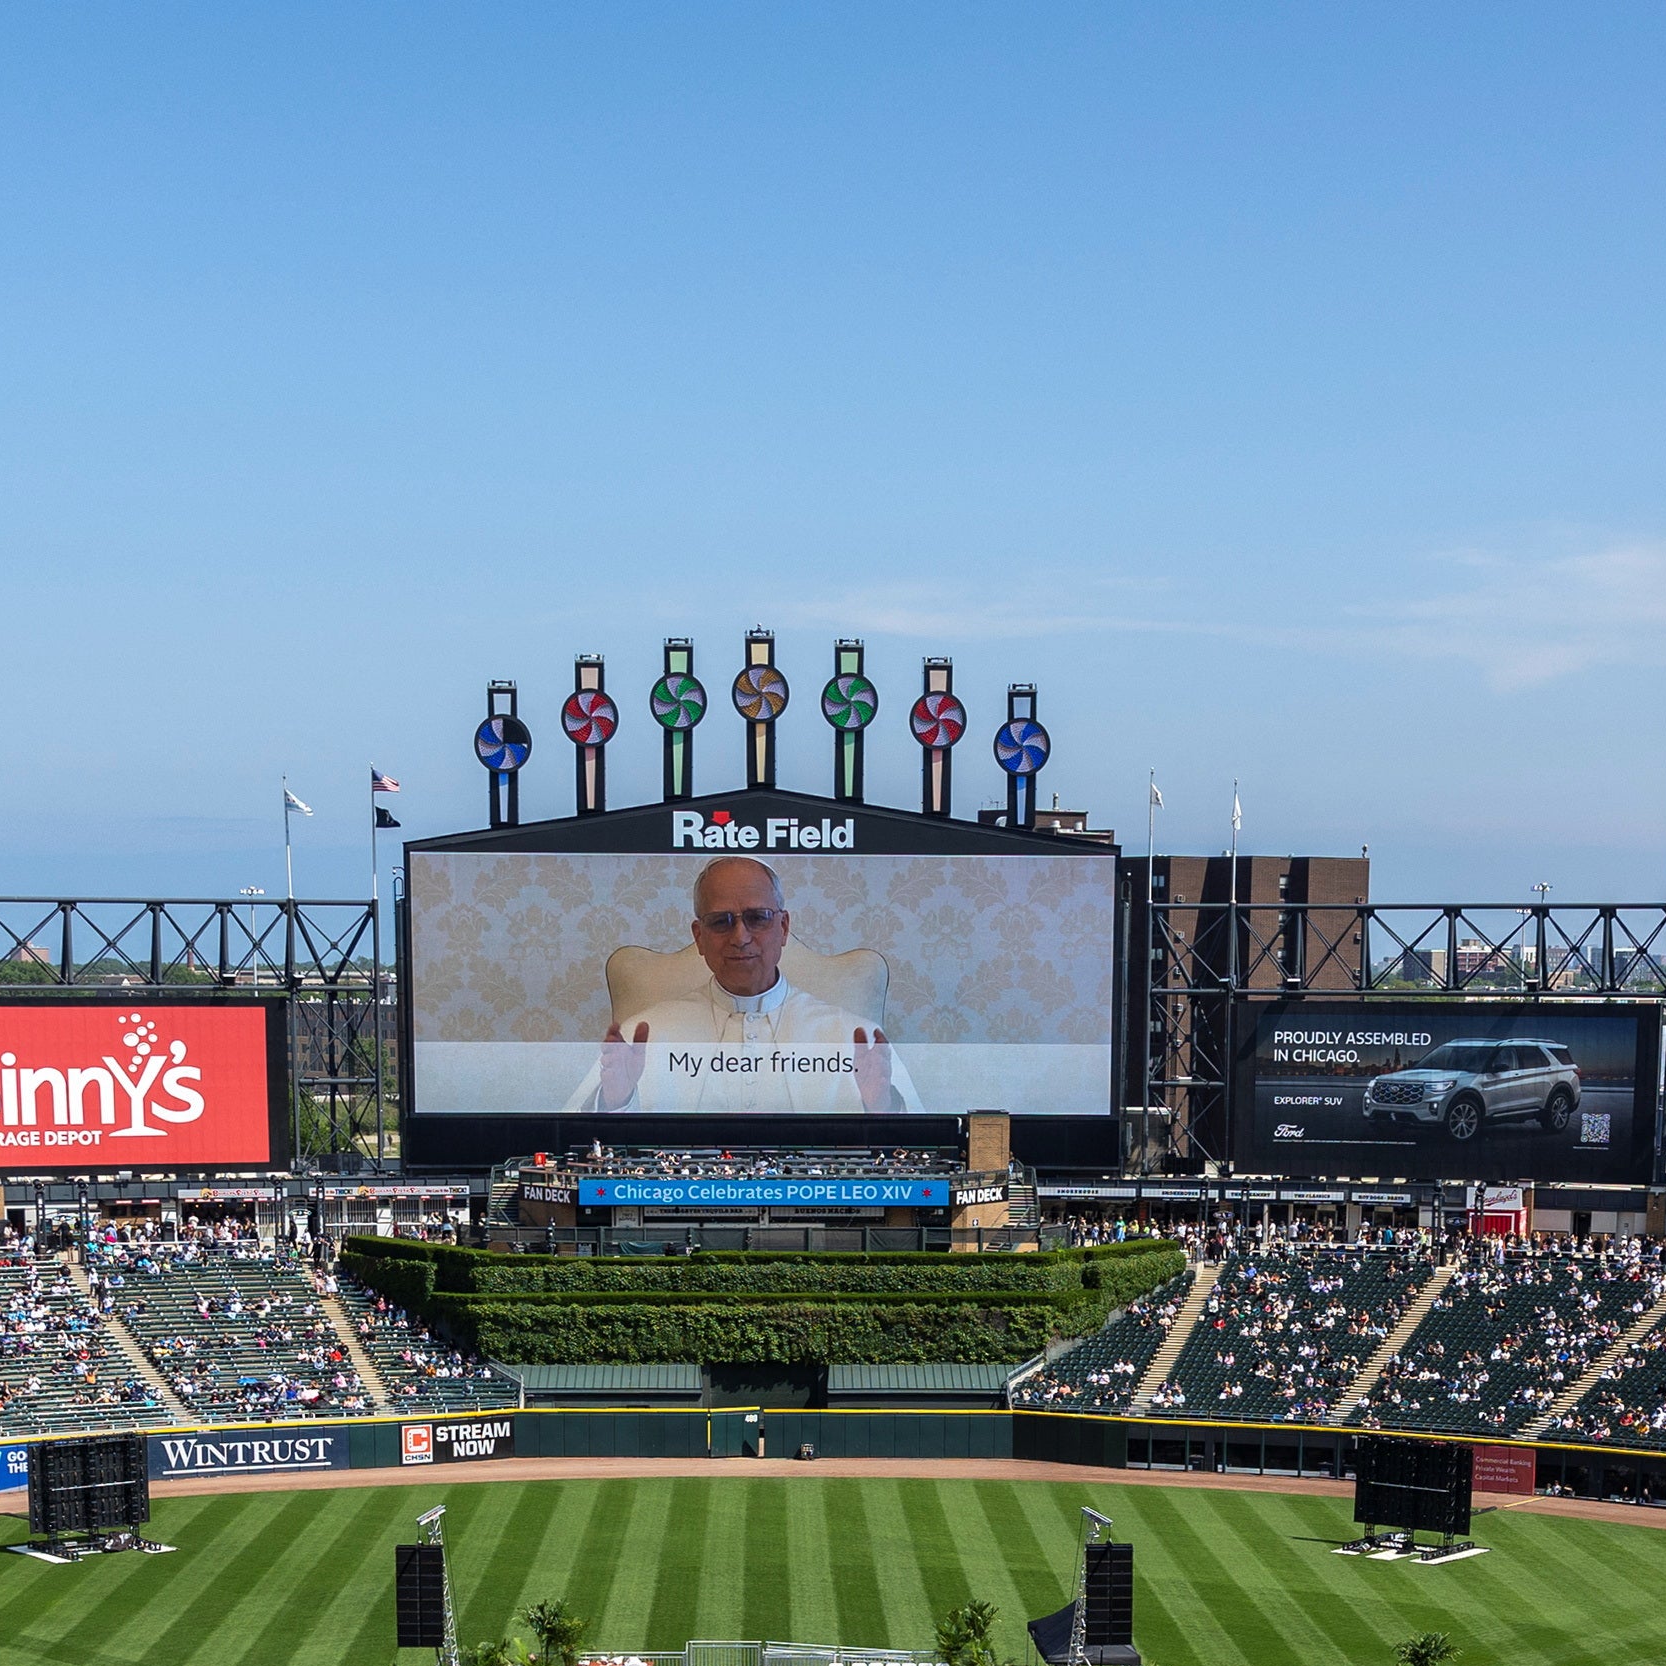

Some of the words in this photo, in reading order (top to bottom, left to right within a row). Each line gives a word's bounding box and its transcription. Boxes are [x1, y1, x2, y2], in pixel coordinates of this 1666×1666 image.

[673, 811, 759, 849] Rate
[766, 817, 854, 849] Field
[1274, 1031, 1342, 1044] PROUDLY
[1346, 1032, 1432, 1046] ASSEMBLED
[668, 1052, 701, 1078] My
[710, 1050, 761, 1073] dear
[769, 1049, 860, 1074] friends.
[1274, 1049, 1288, 1062] IN
[1292, 1049, 1361, 1062] CHICAGO.
[1324, 1097, 1343, 1105] SUV
[44, 1130, 102, 1146] DEPOT
[1273, 1124, 1305, 1138] Ford
[524, 1186, 543, 1201] FAN
[545, 1188, 571, 1204] DECK
[614, 1184, 684, 1203] Chicago
[688, 1184, 783, 1200] Celebrates
[787, 1185, 836, 1200] POPE
[841, 1185, 878, 1200] LEO
[882, 1185, 913, 1200] XIV
[956, 1189, 976, 1205] FAN
[977, 1186, 1003, 1202] DECK
[436, 1422, 511, 1443] STREAM
[161, 1437, 334, 1468] WINTRUST
[452, 1438, 495, 1457] NOW
[404, 1453, 432, 1462] CHSN
[1509, 1458, 1532, 1468] Banking
[1475, 1465, 1495, 1473] Private
[1475, 1474, 1495, 1482] Capital
